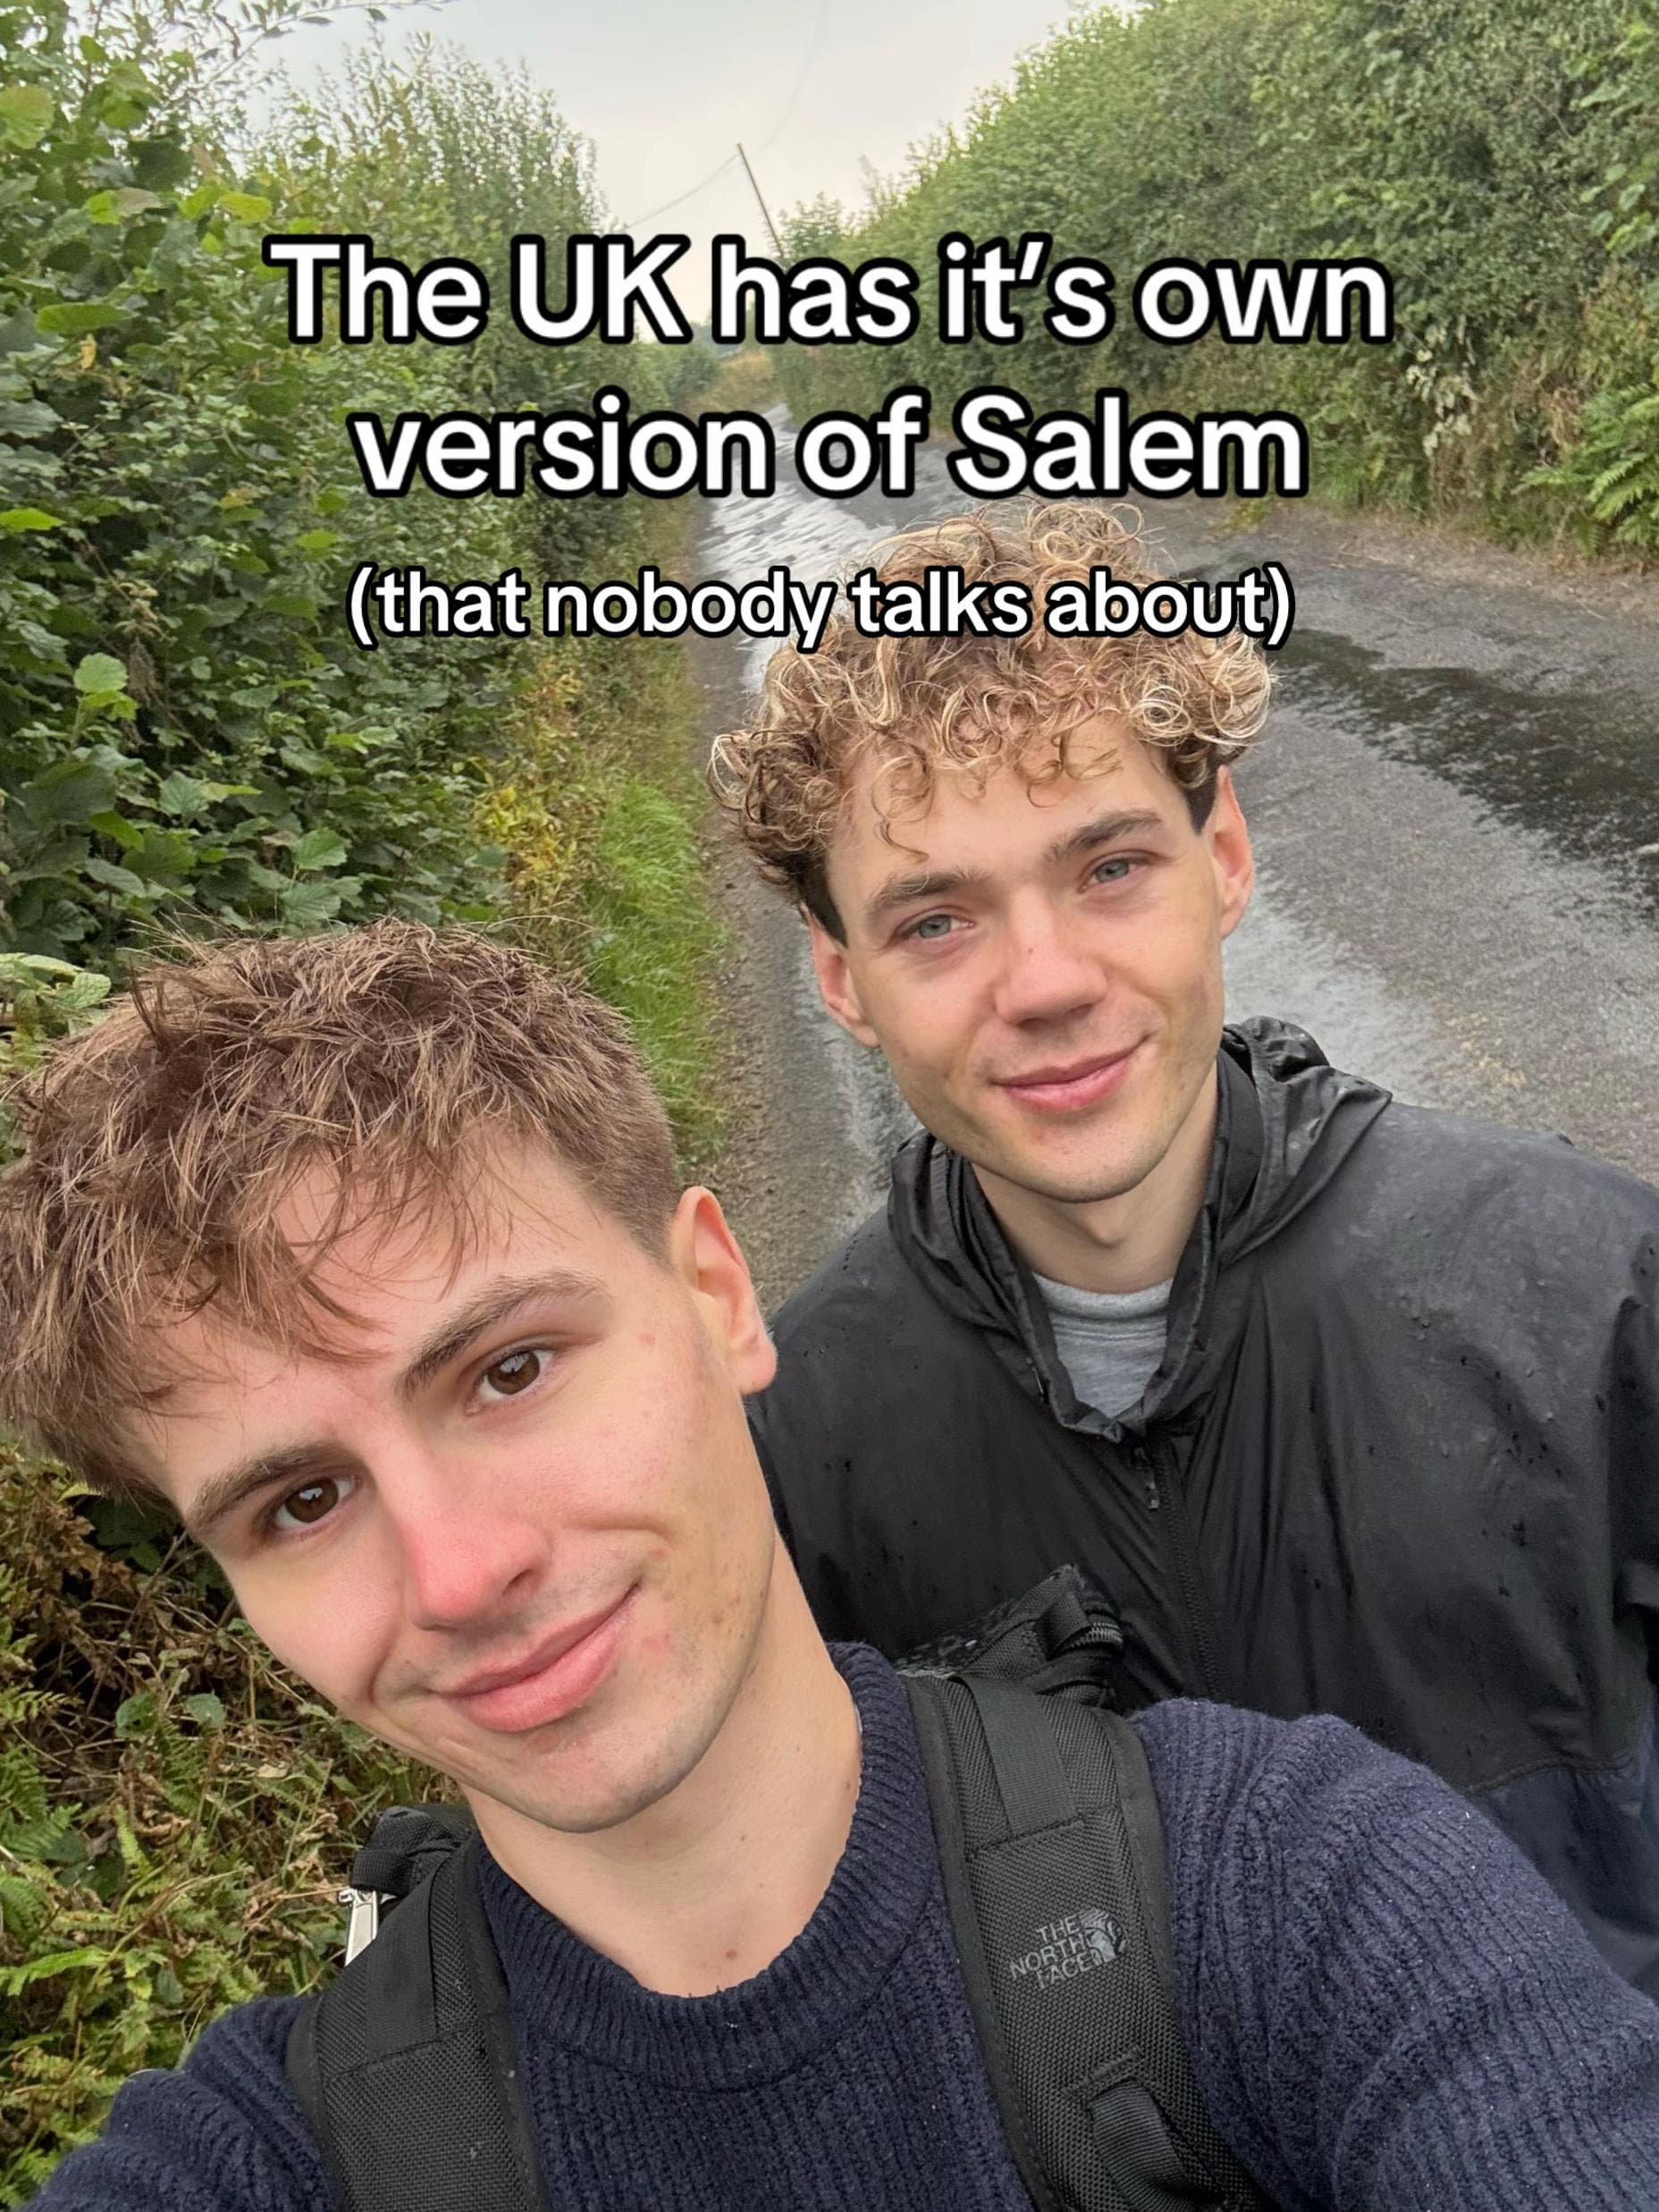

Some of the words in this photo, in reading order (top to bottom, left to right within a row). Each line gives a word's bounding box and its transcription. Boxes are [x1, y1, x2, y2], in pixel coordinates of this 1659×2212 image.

[1036, 1914, 1080, 1942] THE
[1009, 1933, 1086, 1980] NORTH
[1037, 1951, 1092, 1989] FACE
